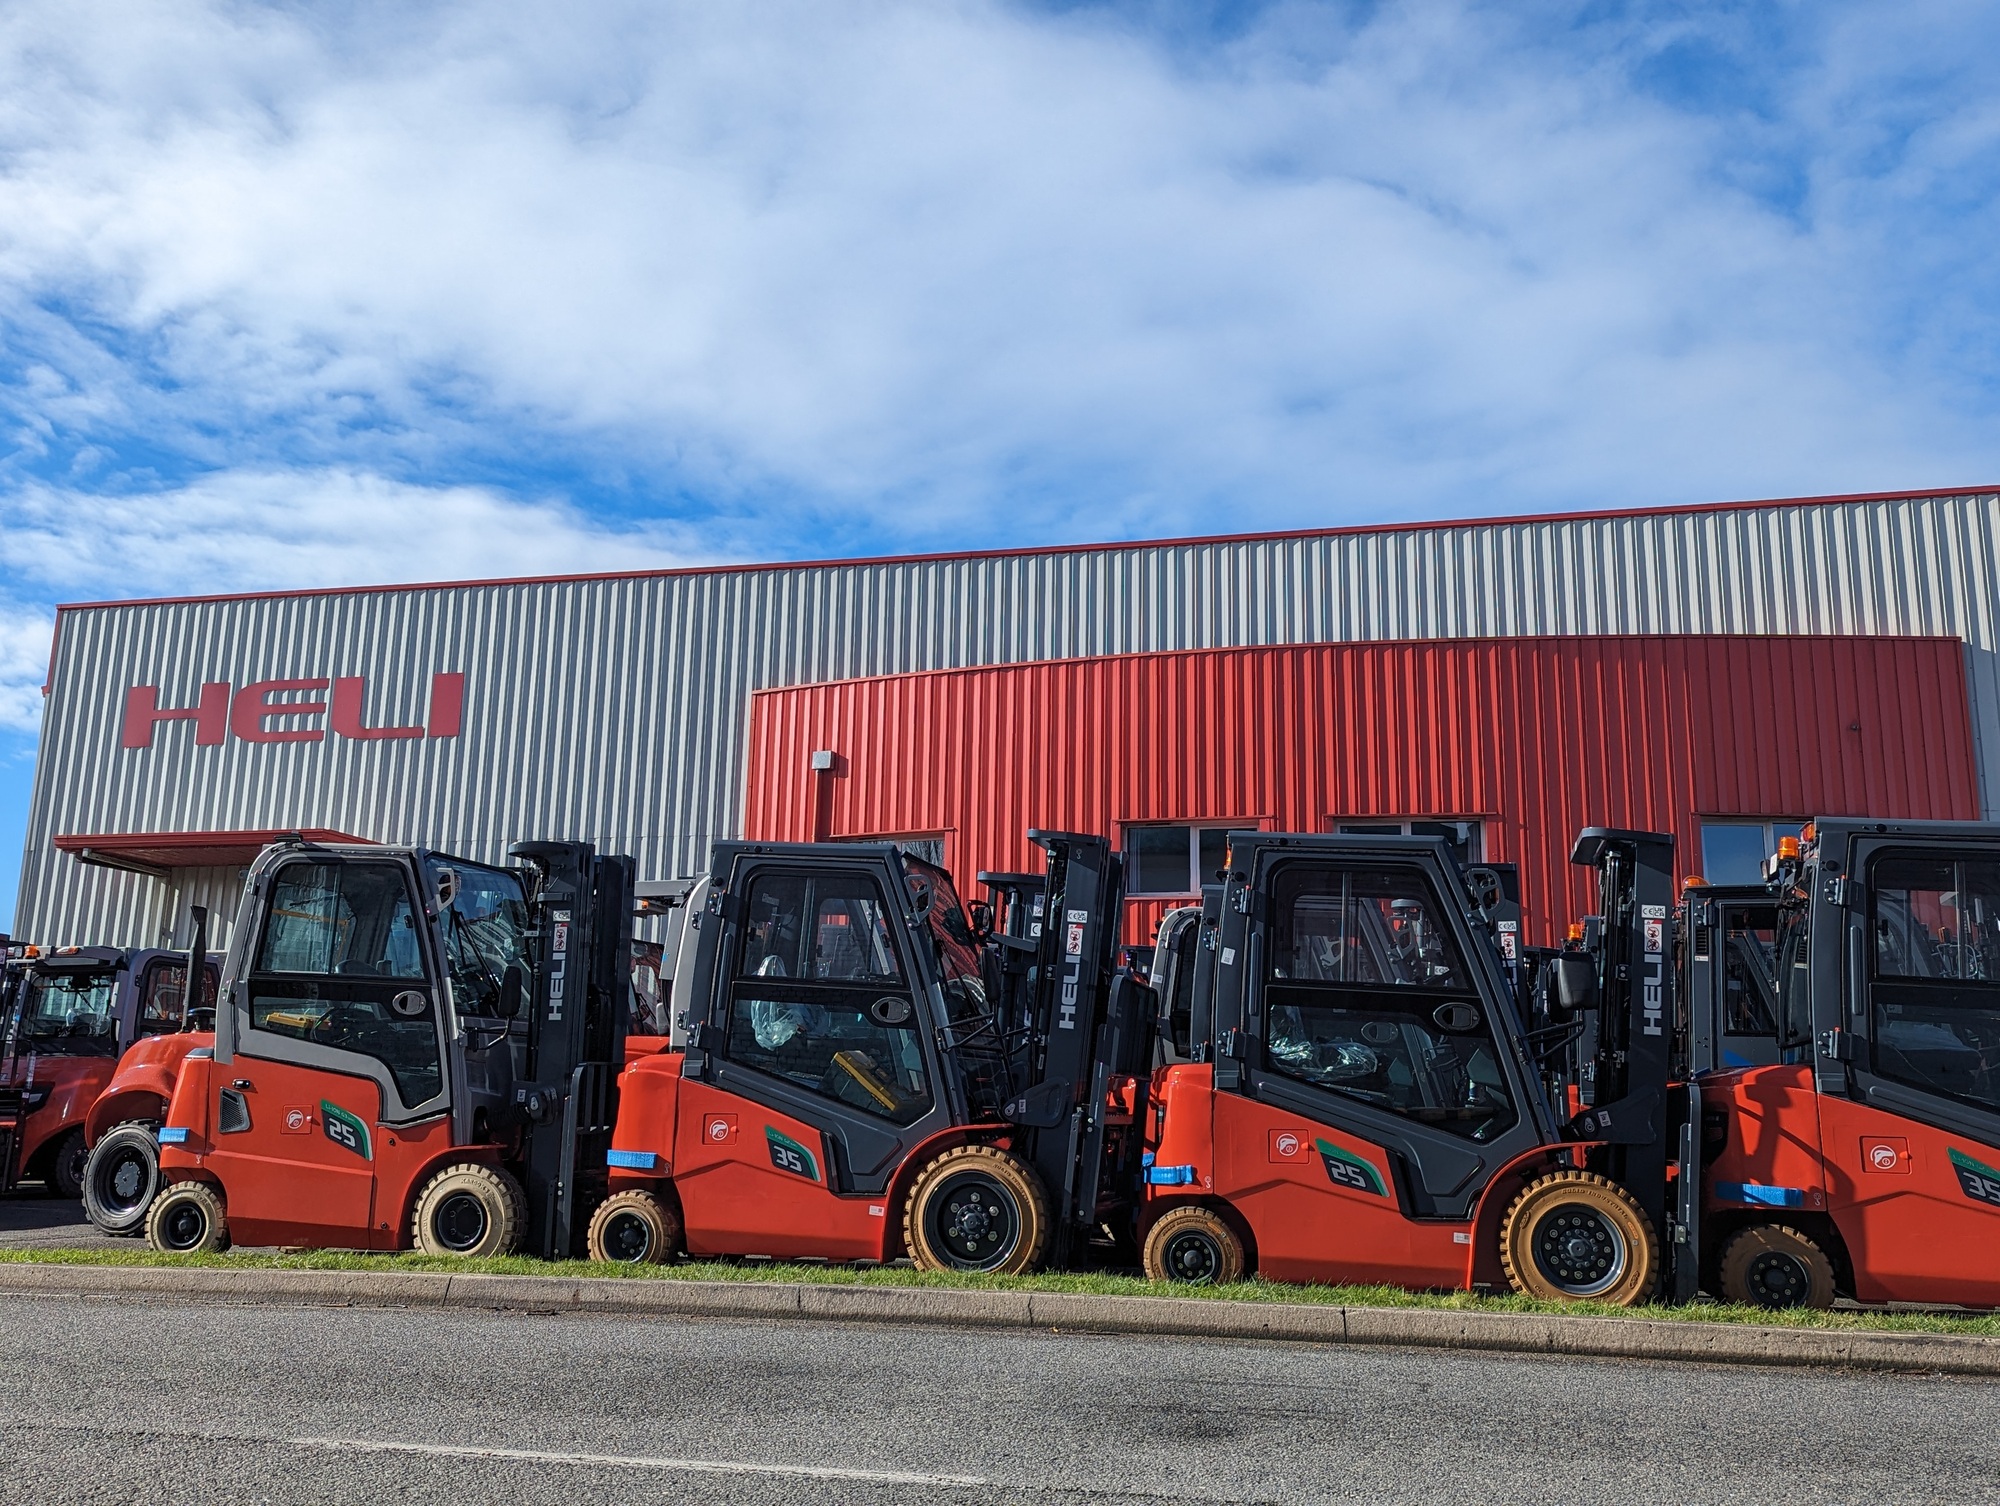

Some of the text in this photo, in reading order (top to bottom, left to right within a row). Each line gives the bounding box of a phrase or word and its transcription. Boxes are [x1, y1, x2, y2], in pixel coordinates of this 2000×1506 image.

[122, 672, 466, 749] HELI
[548, 952, 567, 1021] HELI
[1058, 954, 1081, 1030] HELI
[1643, 953, 1663, 1036] HELI
[328, 1117, 356, 1148] 25
[773, 1145, 803, 1172] 35
[1329, 1160, 1366, 1188] 25
[1962, 1171, 2000, 1203] 35
